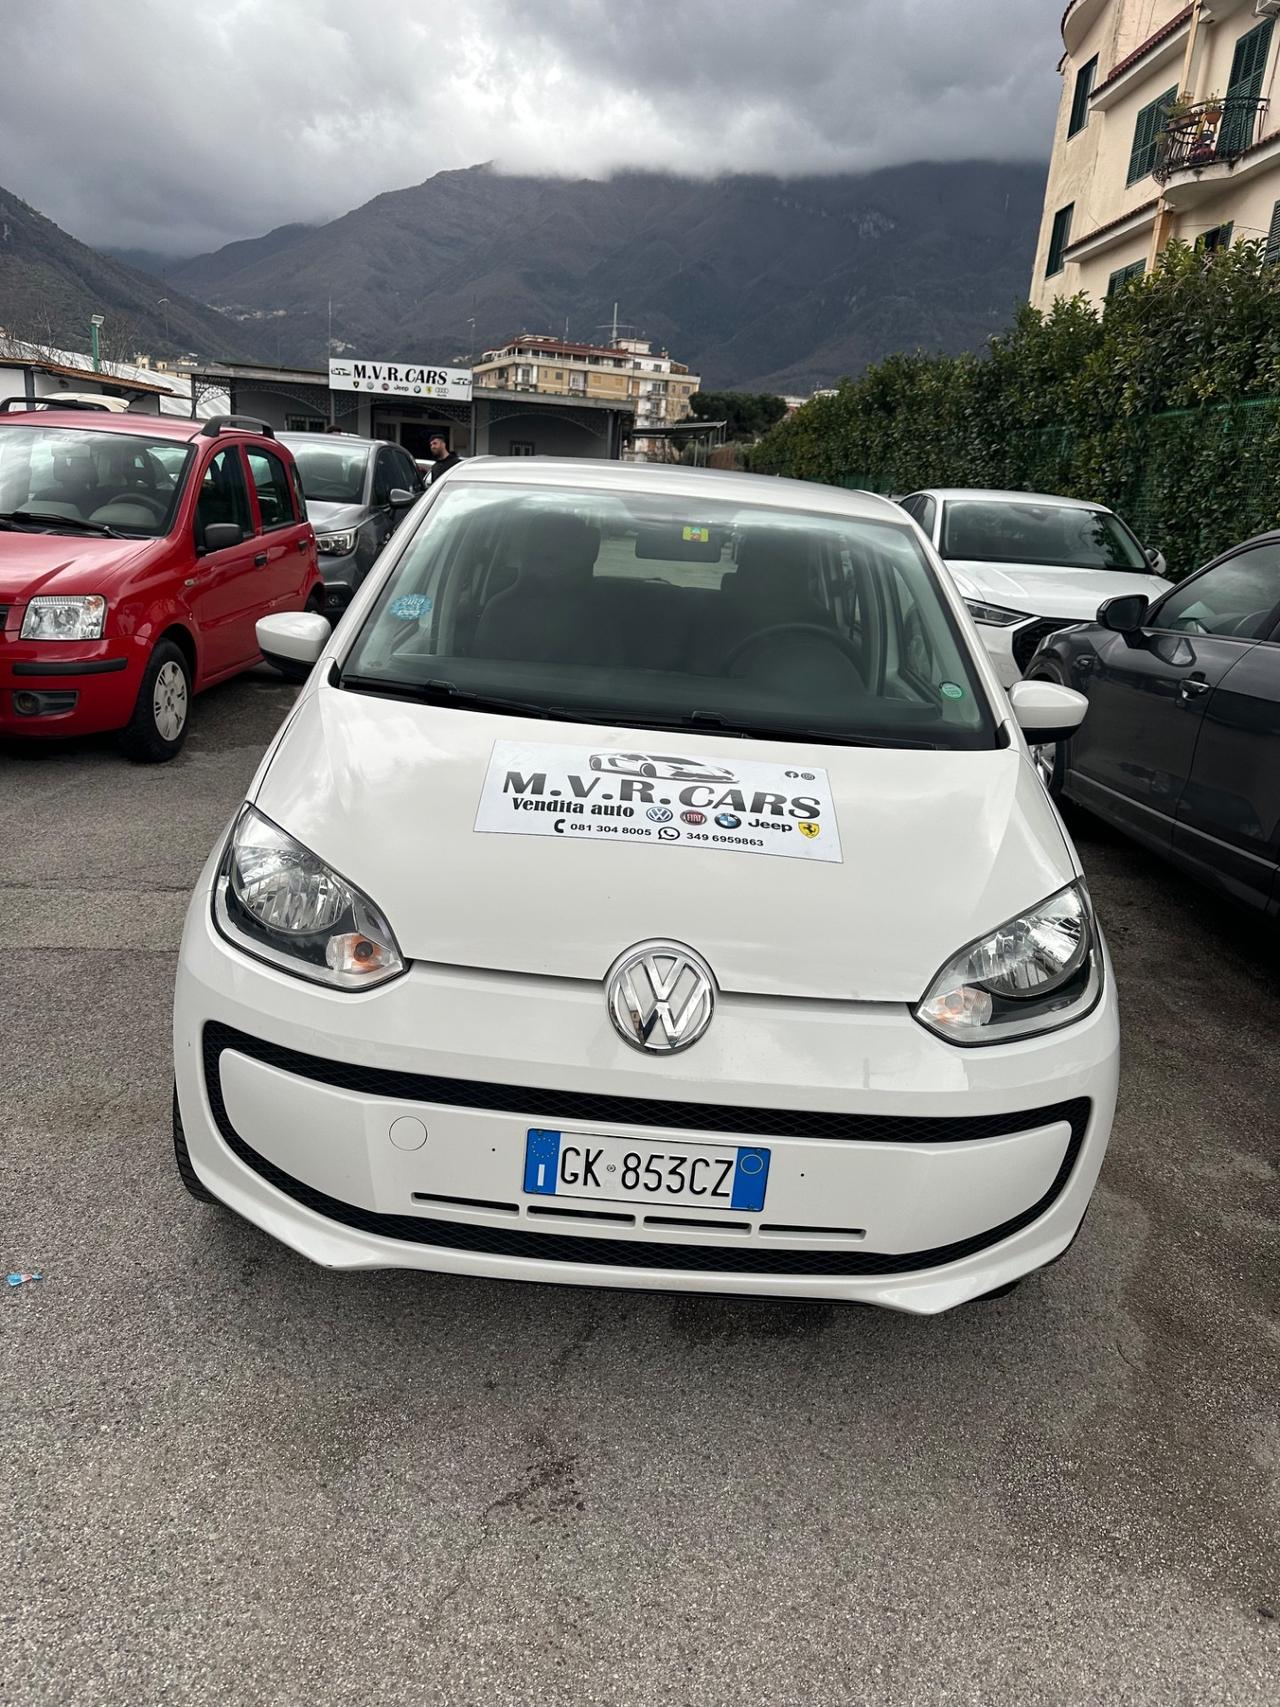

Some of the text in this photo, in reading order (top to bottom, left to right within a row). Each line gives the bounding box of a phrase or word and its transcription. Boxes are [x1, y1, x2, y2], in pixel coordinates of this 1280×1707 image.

[512, 797, 635, 817] Vendita auto
[686, 813, 702, 822] FIAT
[570, 823, 651, 836] 081 304 8005
[748, 819, 793, 833] Jeep
[686, 833, 764, 847] 349 6959863
[560, 1147, 734, 1197] GK 853CZ
